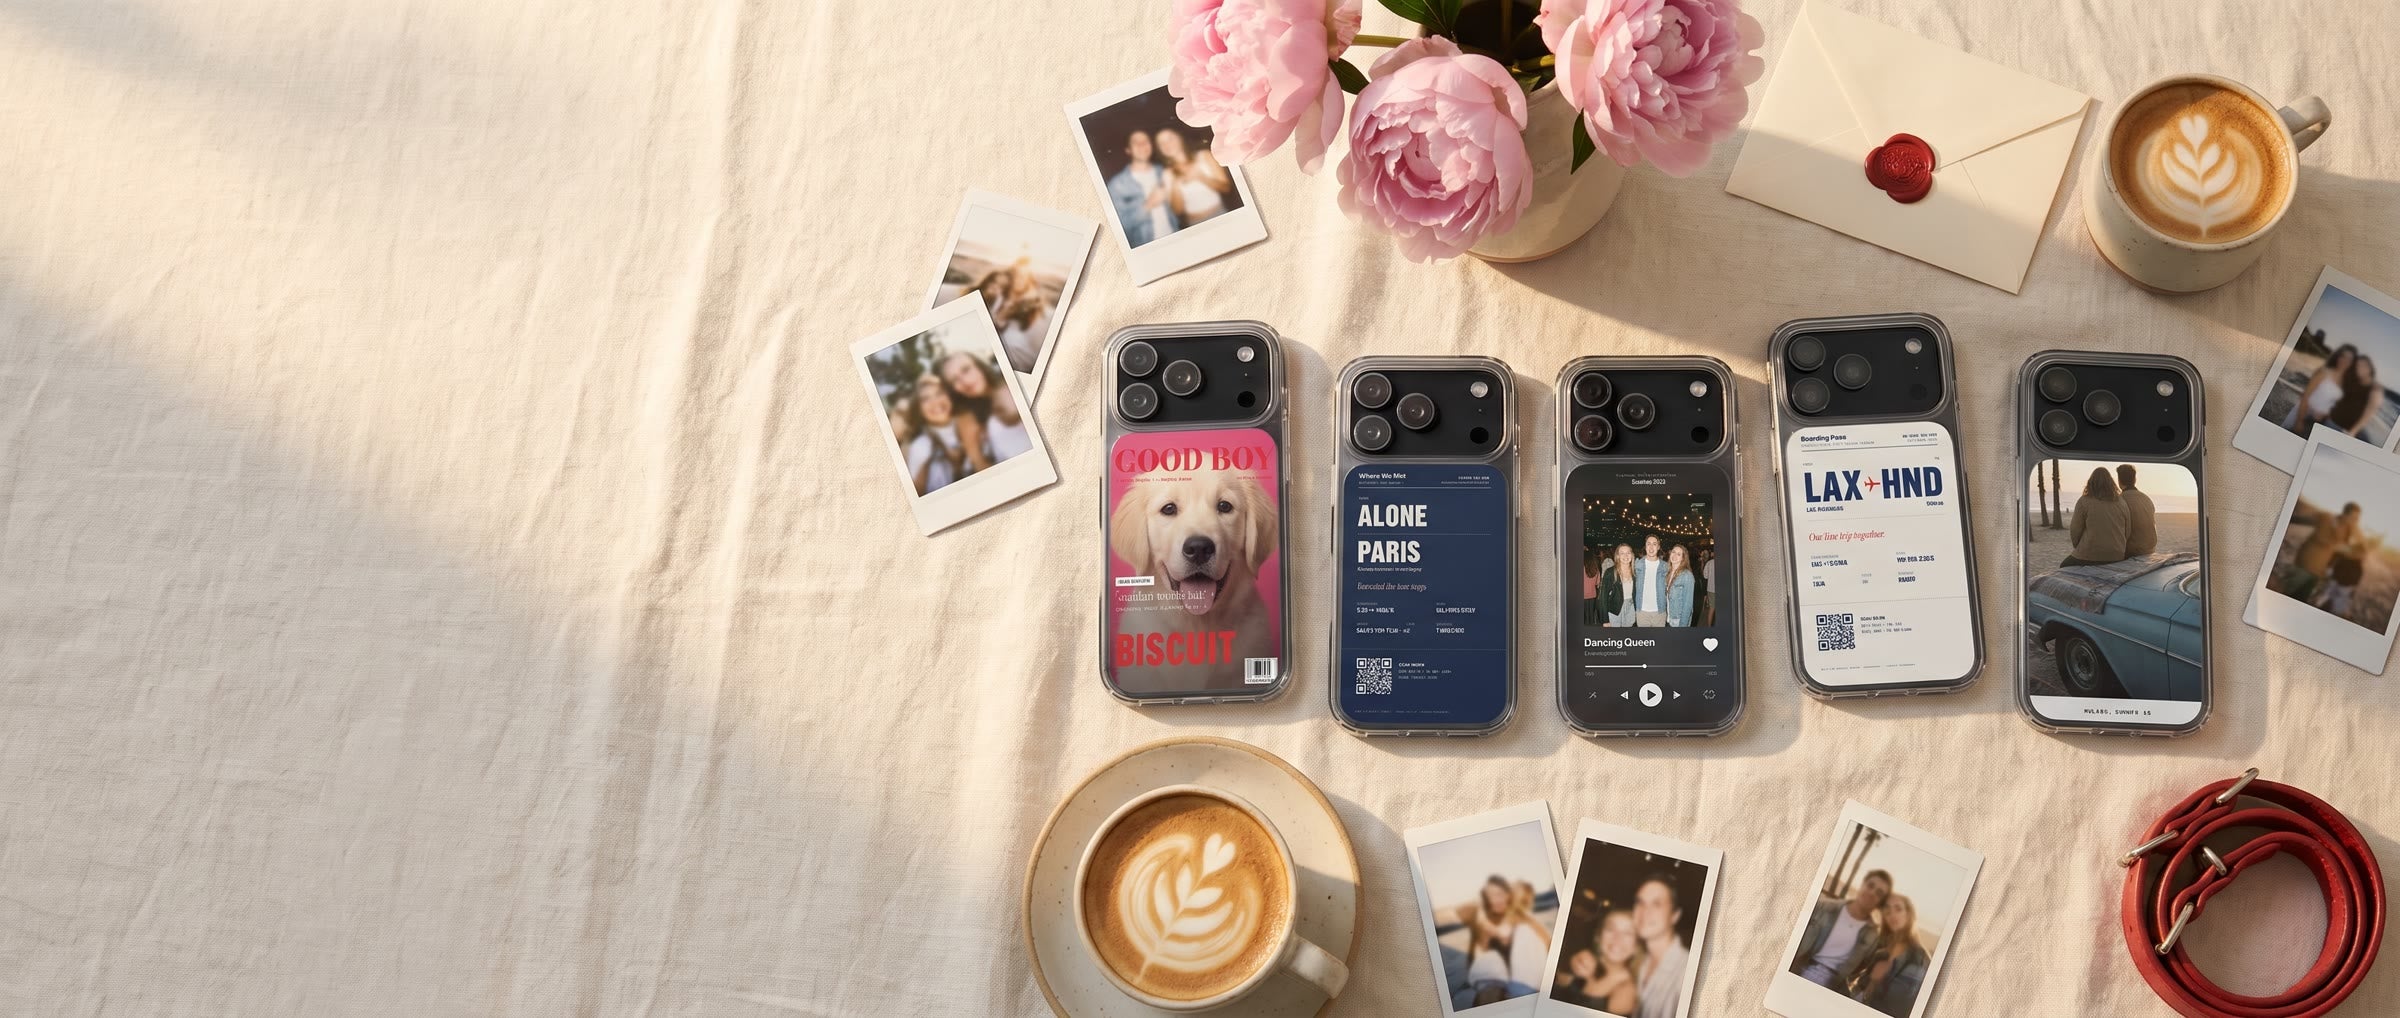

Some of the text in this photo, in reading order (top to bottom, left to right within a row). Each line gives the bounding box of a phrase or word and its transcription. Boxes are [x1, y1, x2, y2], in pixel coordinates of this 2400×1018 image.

[1800, 434, 1829, 443] Boarding
[1115, 446, 1273, 473] GOOD BOY
[1804, 466, 1944, 503] LAX HND
[1357, 503, 1428, 528] ALONE
[1357, 540, 1421, 564] PARIS
[1116, 629, 1237, 668] BISCUIT
[1584, 637, 1656, 649] Dancing Queen
